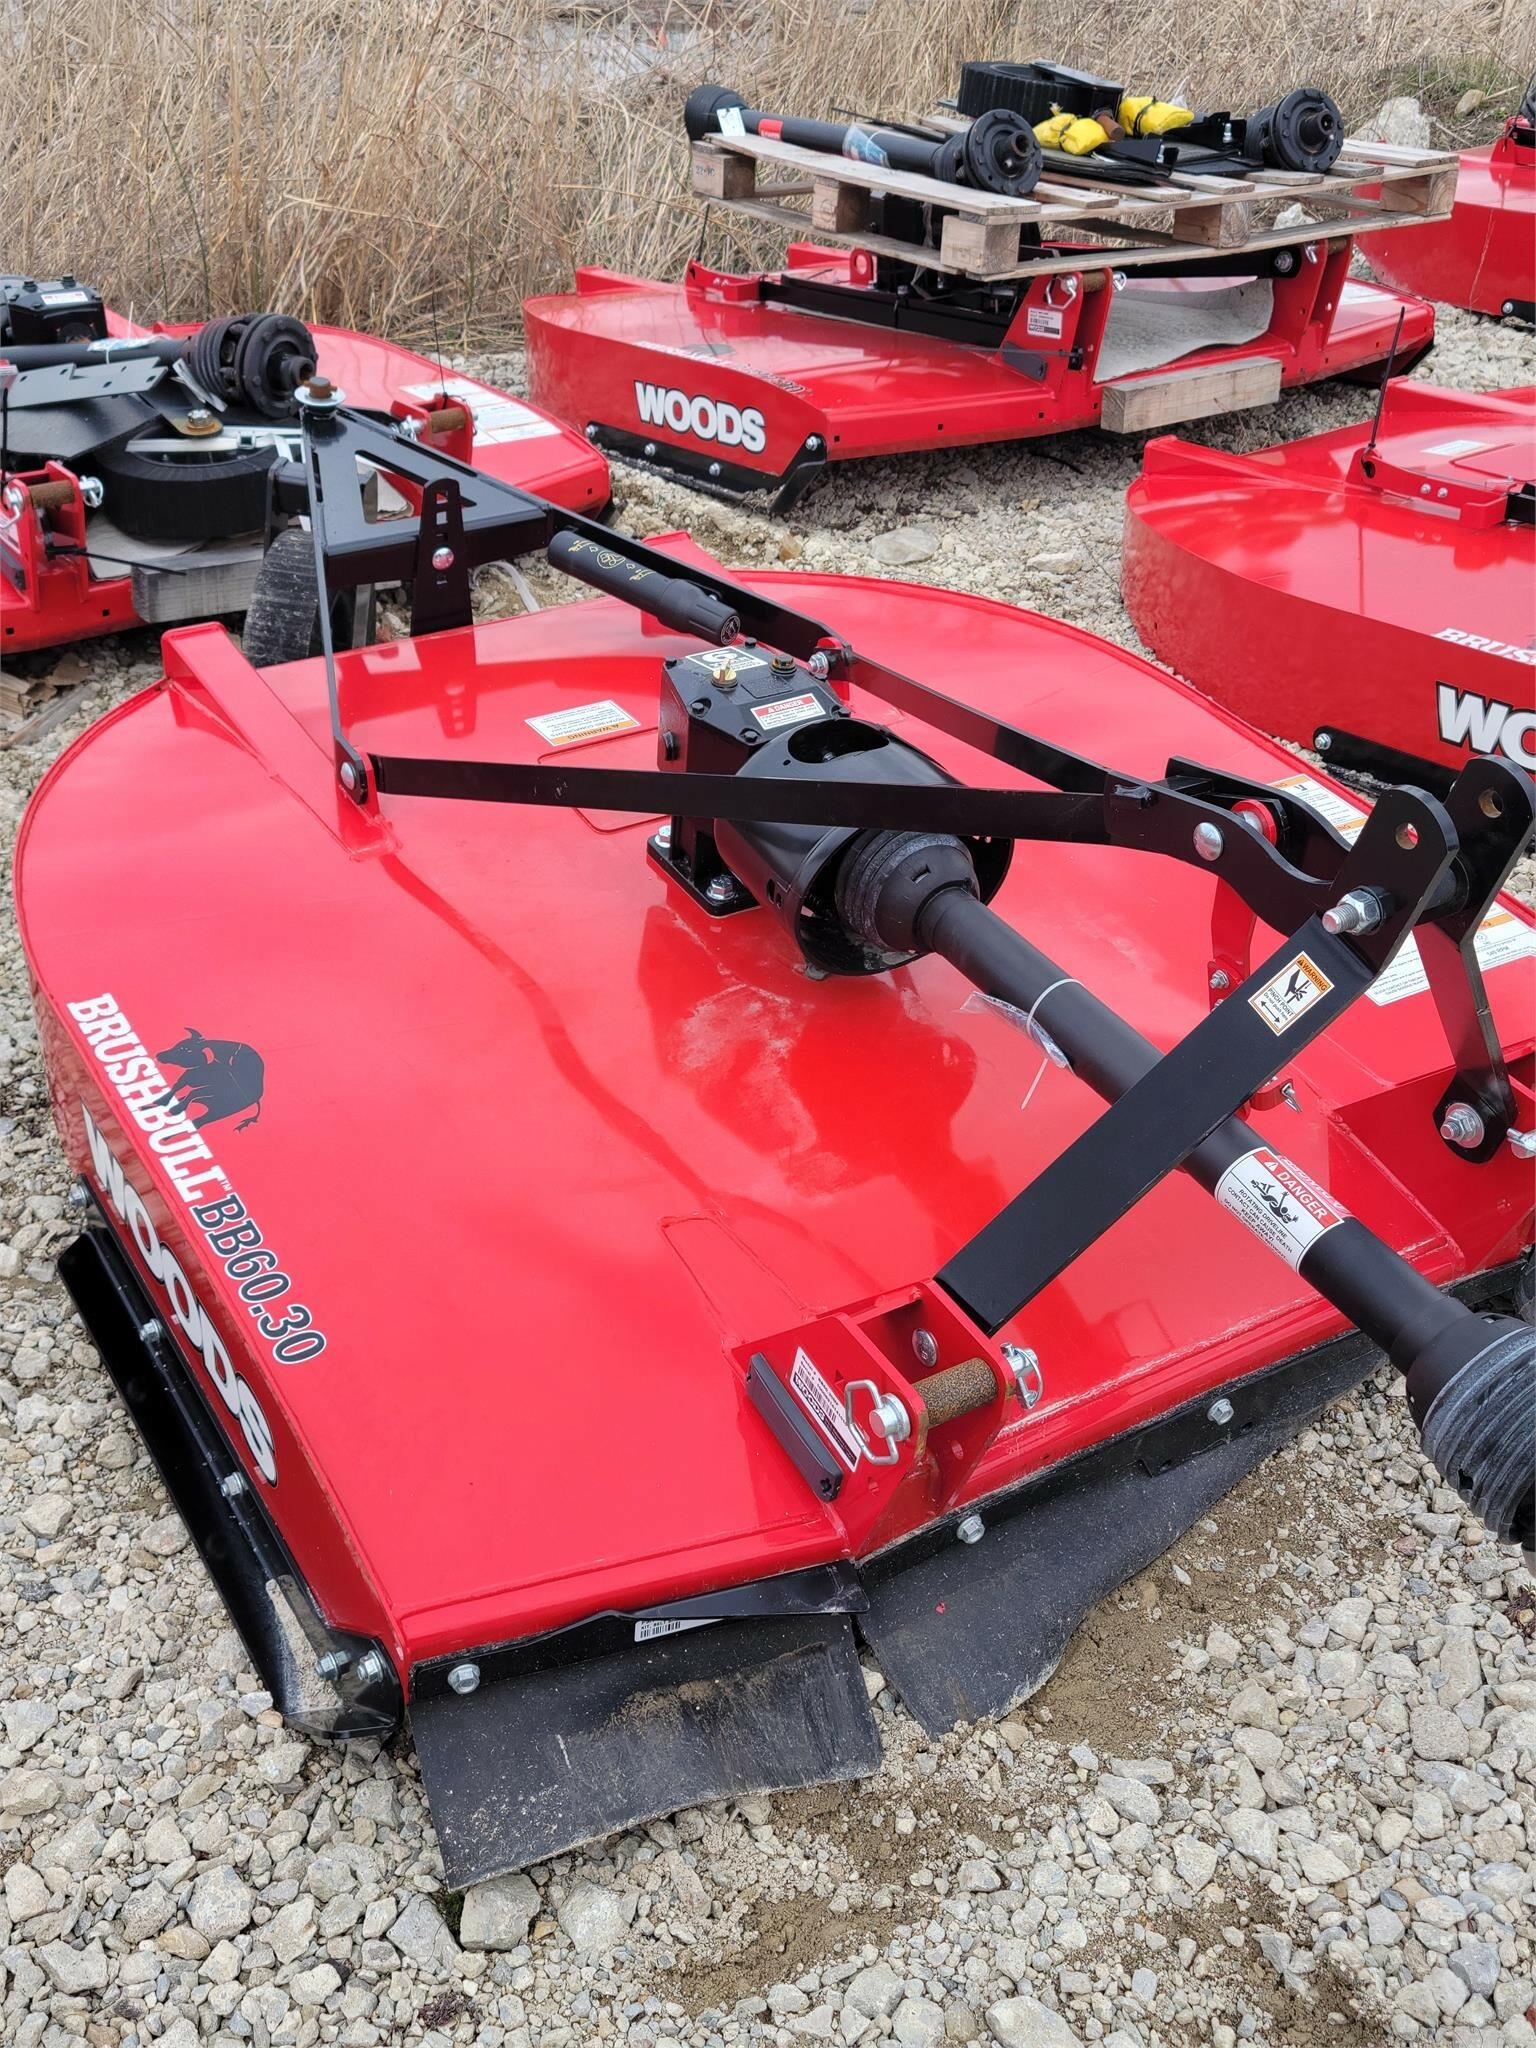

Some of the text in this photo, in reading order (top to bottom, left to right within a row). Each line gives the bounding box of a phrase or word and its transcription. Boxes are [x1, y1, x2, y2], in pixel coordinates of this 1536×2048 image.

[634, 379, 766, 453] WOODS
[1302, 963, 1328, 991] WARNING
[1268, 987, 1294, 1017] PINCH POINT
[1239, 1189, 1288, 1239] ROTATING DRIVELINE
[1241, 1208, 1256, 1224] KEEP
[1277, 1170, 1328, 1219] DANGER
[1227, 1187, 1293, 1253] CONTACT CAN CAUSE DEATH
[81, 1097, 277, 1489] WOODS
[188, 1193, 326, 1364] BB60.30
[795, 1374, 825, 1420] WOODS
